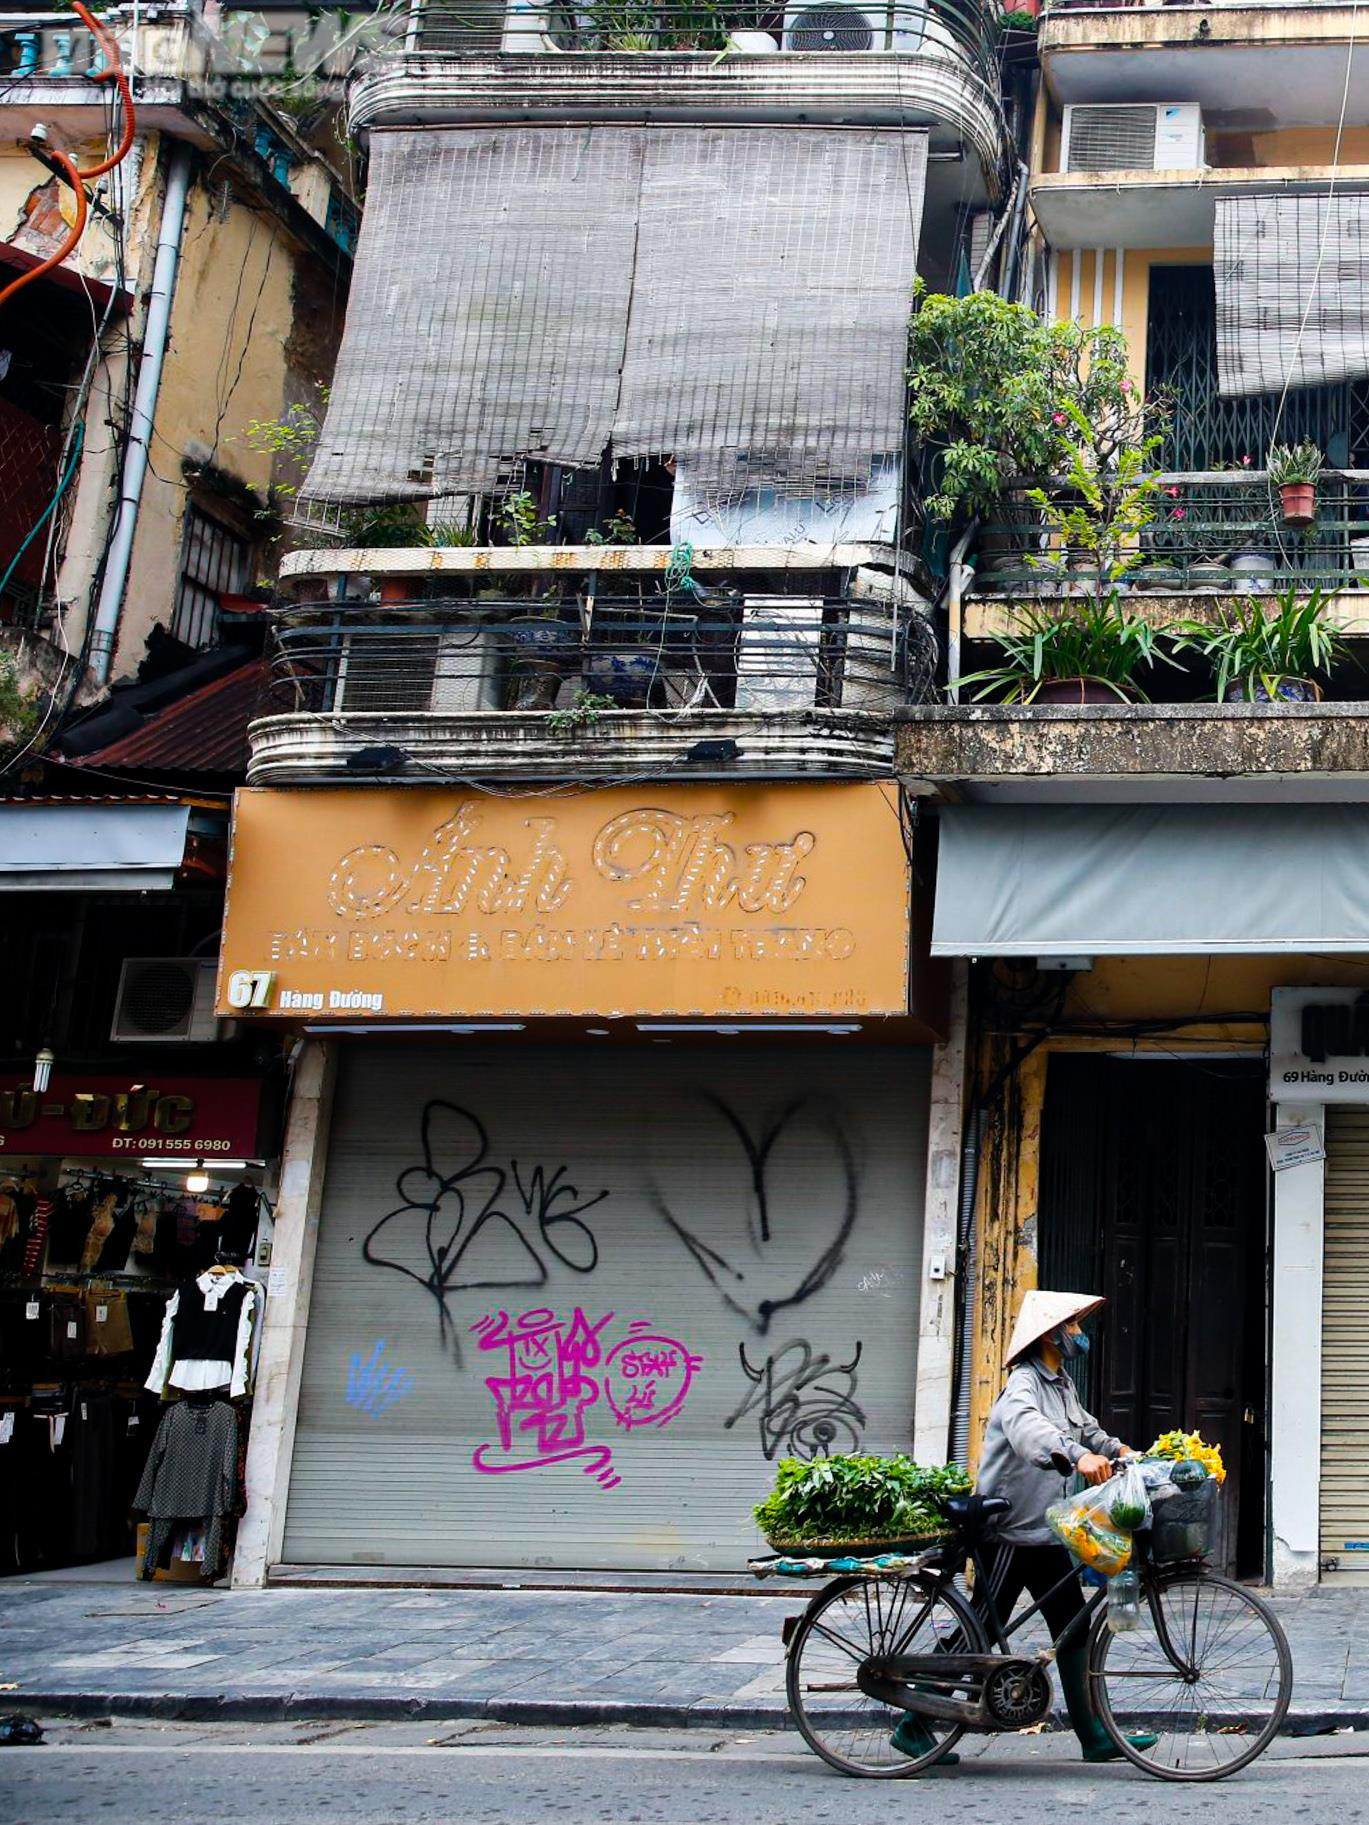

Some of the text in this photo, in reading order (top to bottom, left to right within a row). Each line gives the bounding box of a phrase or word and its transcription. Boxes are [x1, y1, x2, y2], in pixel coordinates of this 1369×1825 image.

[592, 807, 816, 915] Thư
[228, 969, 384, 1011] 67 Hàng Đường
[1282, 1071, 1299, 1083] 69
[1301, 1071, 1334, 1086] Hàng
[194, 1139, 231, 1151] 6980
